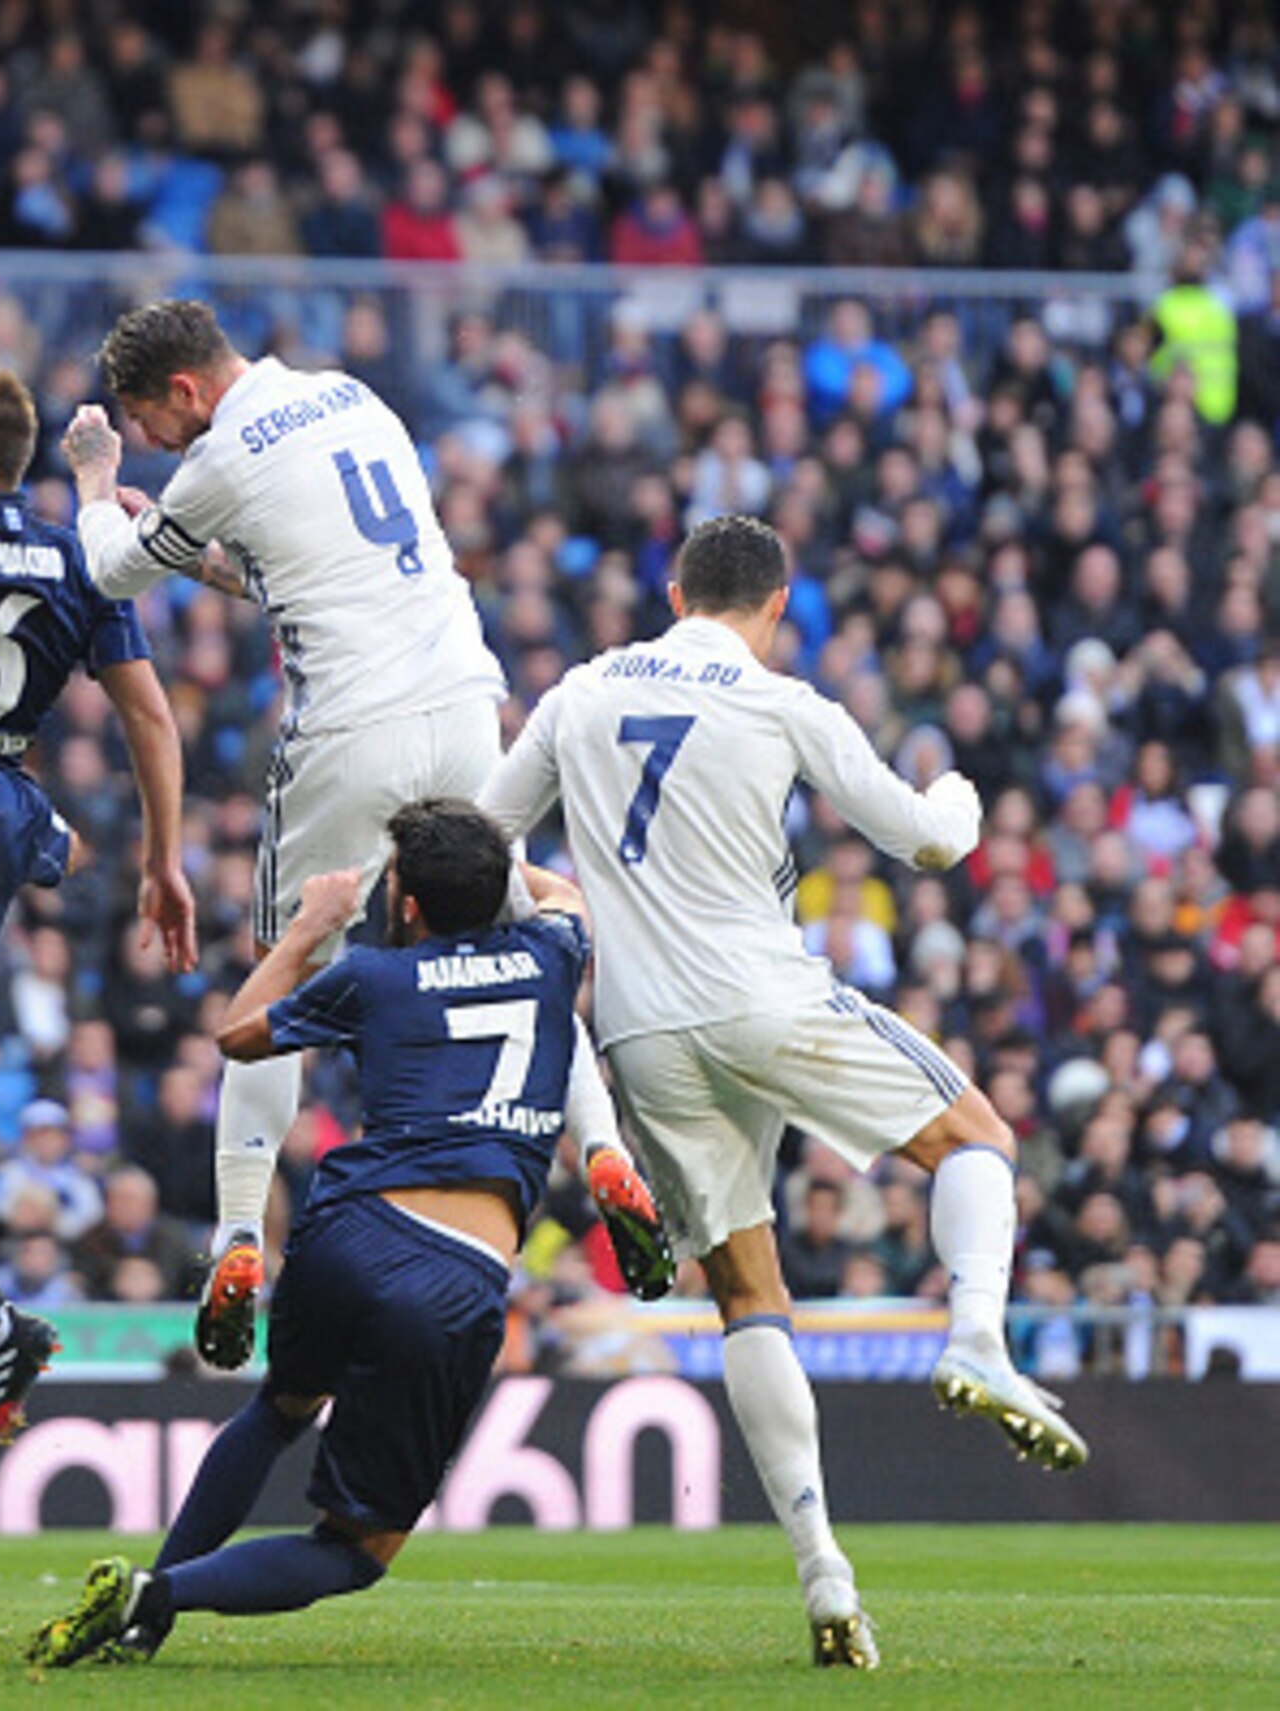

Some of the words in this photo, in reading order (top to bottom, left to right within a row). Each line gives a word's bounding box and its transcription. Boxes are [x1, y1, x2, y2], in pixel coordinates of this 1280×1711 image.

[241, 400, 325, 454] SERGIO
[332, 449, 423, 576] 4
[618, 715, 697, 863] 7
[444, 999, 539, 1112] 7
[410, 1375, 720, 1532] 60
